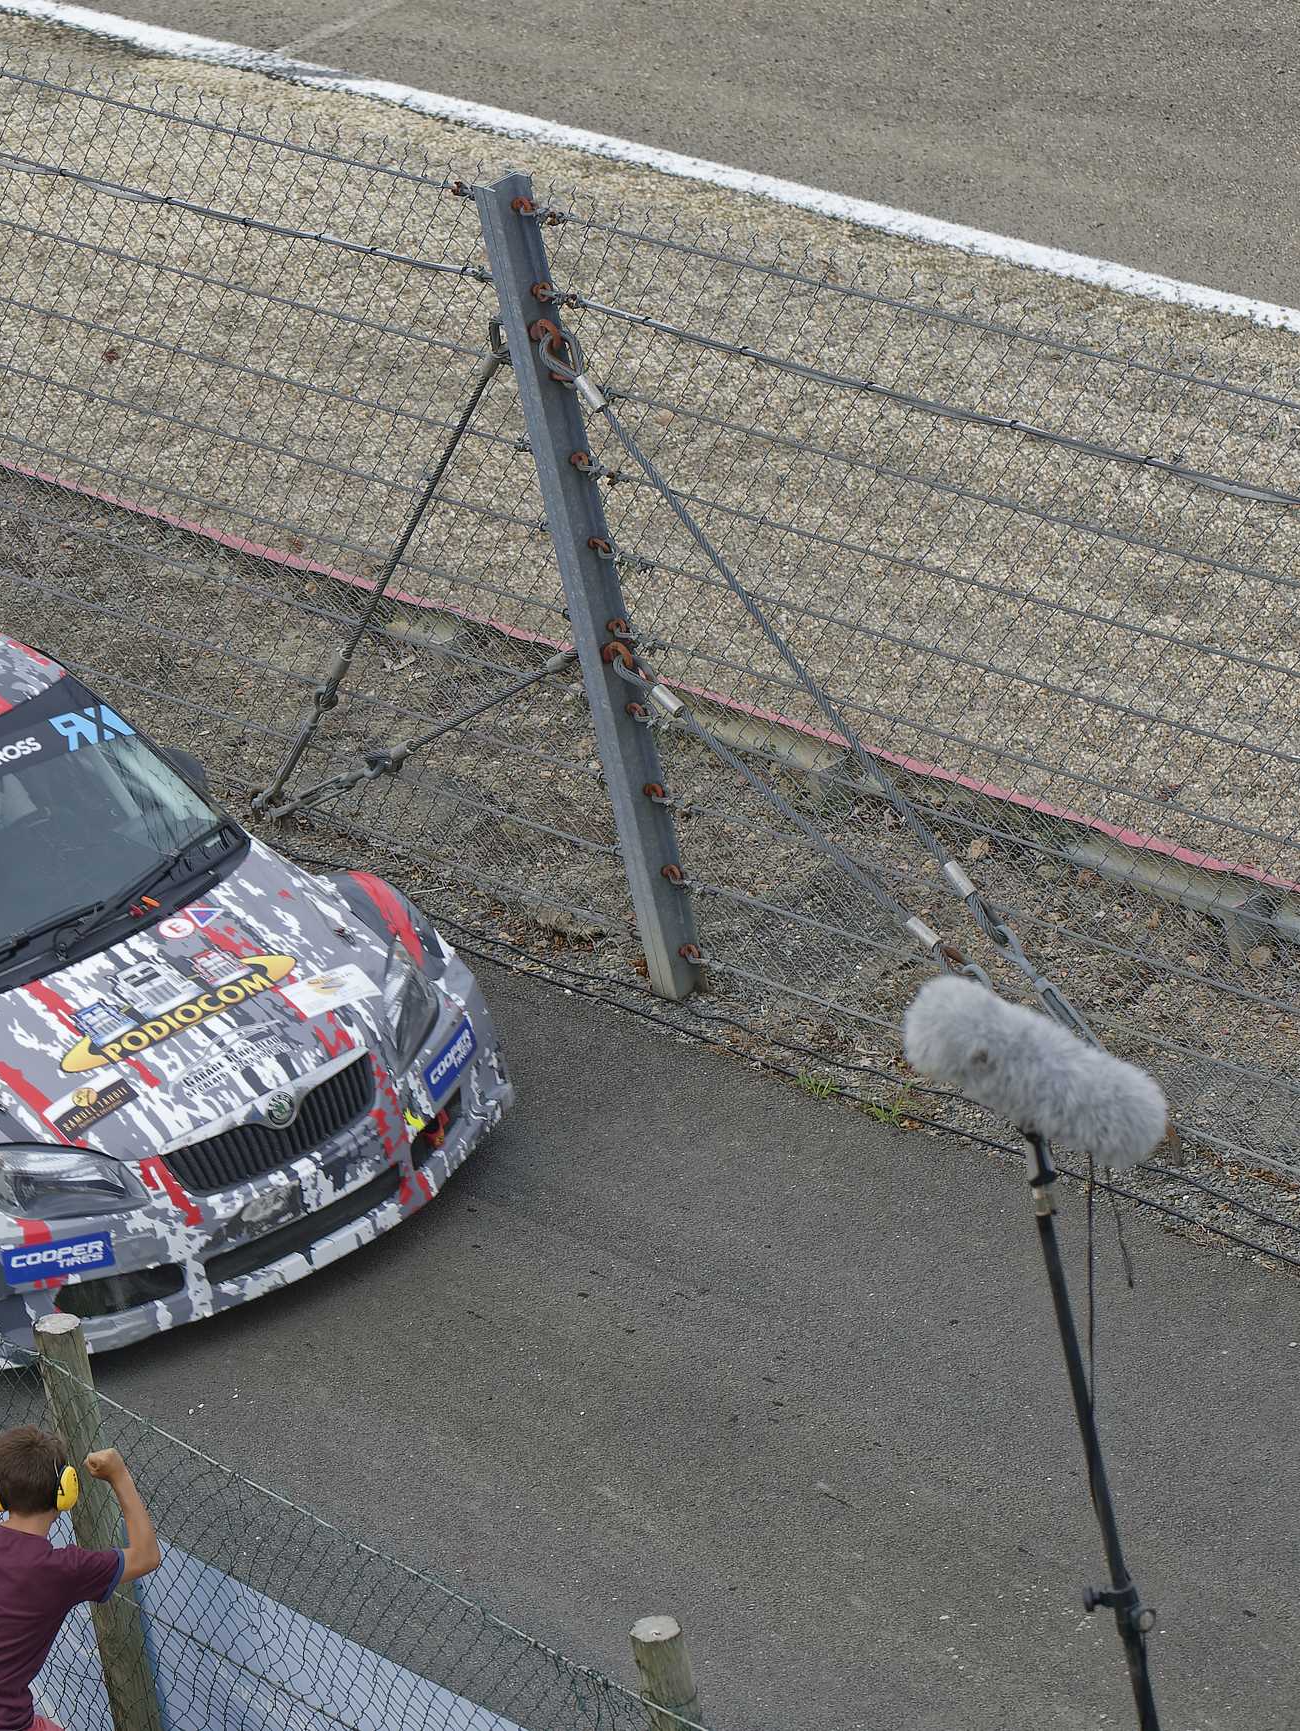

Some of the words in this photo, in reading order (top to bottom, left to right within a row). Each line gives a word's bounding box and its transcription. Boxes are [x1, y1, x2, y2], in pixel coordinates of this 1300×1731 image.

[102, 973, 273, 1061] PODIOCOM
[430, 1029, 471, 1084] COOPER
[11, 1240, 104, 1268] COOPER
[57, 1252, 104, 1268] TIRES
